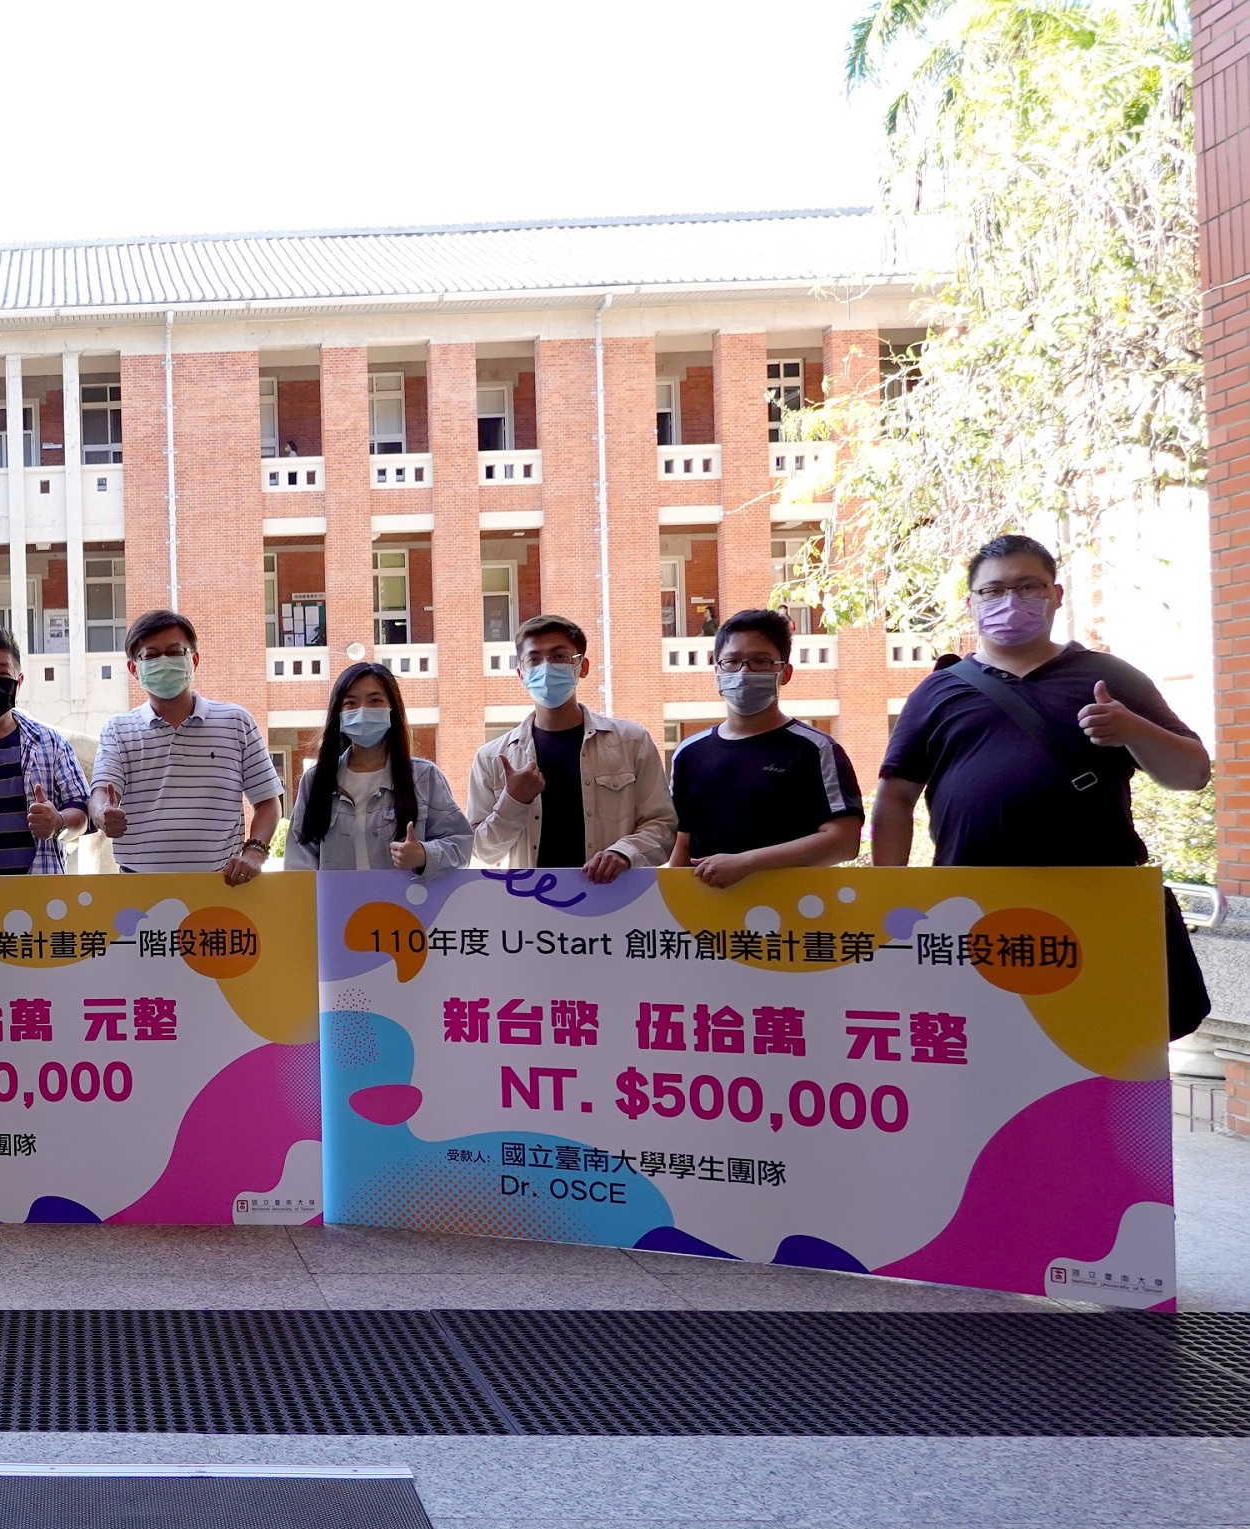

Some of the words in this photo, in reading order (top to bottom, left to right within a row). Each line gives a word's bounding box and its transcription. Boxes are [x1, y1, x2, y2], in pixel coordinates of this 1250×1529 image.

[370, 928, 490, 957] 110年度
[502, 930, 612, 956] U-Start
[625, 928, 1078, 970] 創新創業計畫第一階段補助
[83, 997, 178, 1042] 元整
[443, 997, 599, 1047] 新台幣
[635, 1001, 807, 1057] 伍拾萬
[845, 1010, 968, 1065] 元整
[501, 1065, 593, 1113] NT.
[615, 1066, 910, 1134] $500,000
[501, 1141, 787, 1187] 國立臺南大學學生團隊
[501, 1175, 538, 1198] Dr.
[550, 1179, 627, 1205] OSCE
